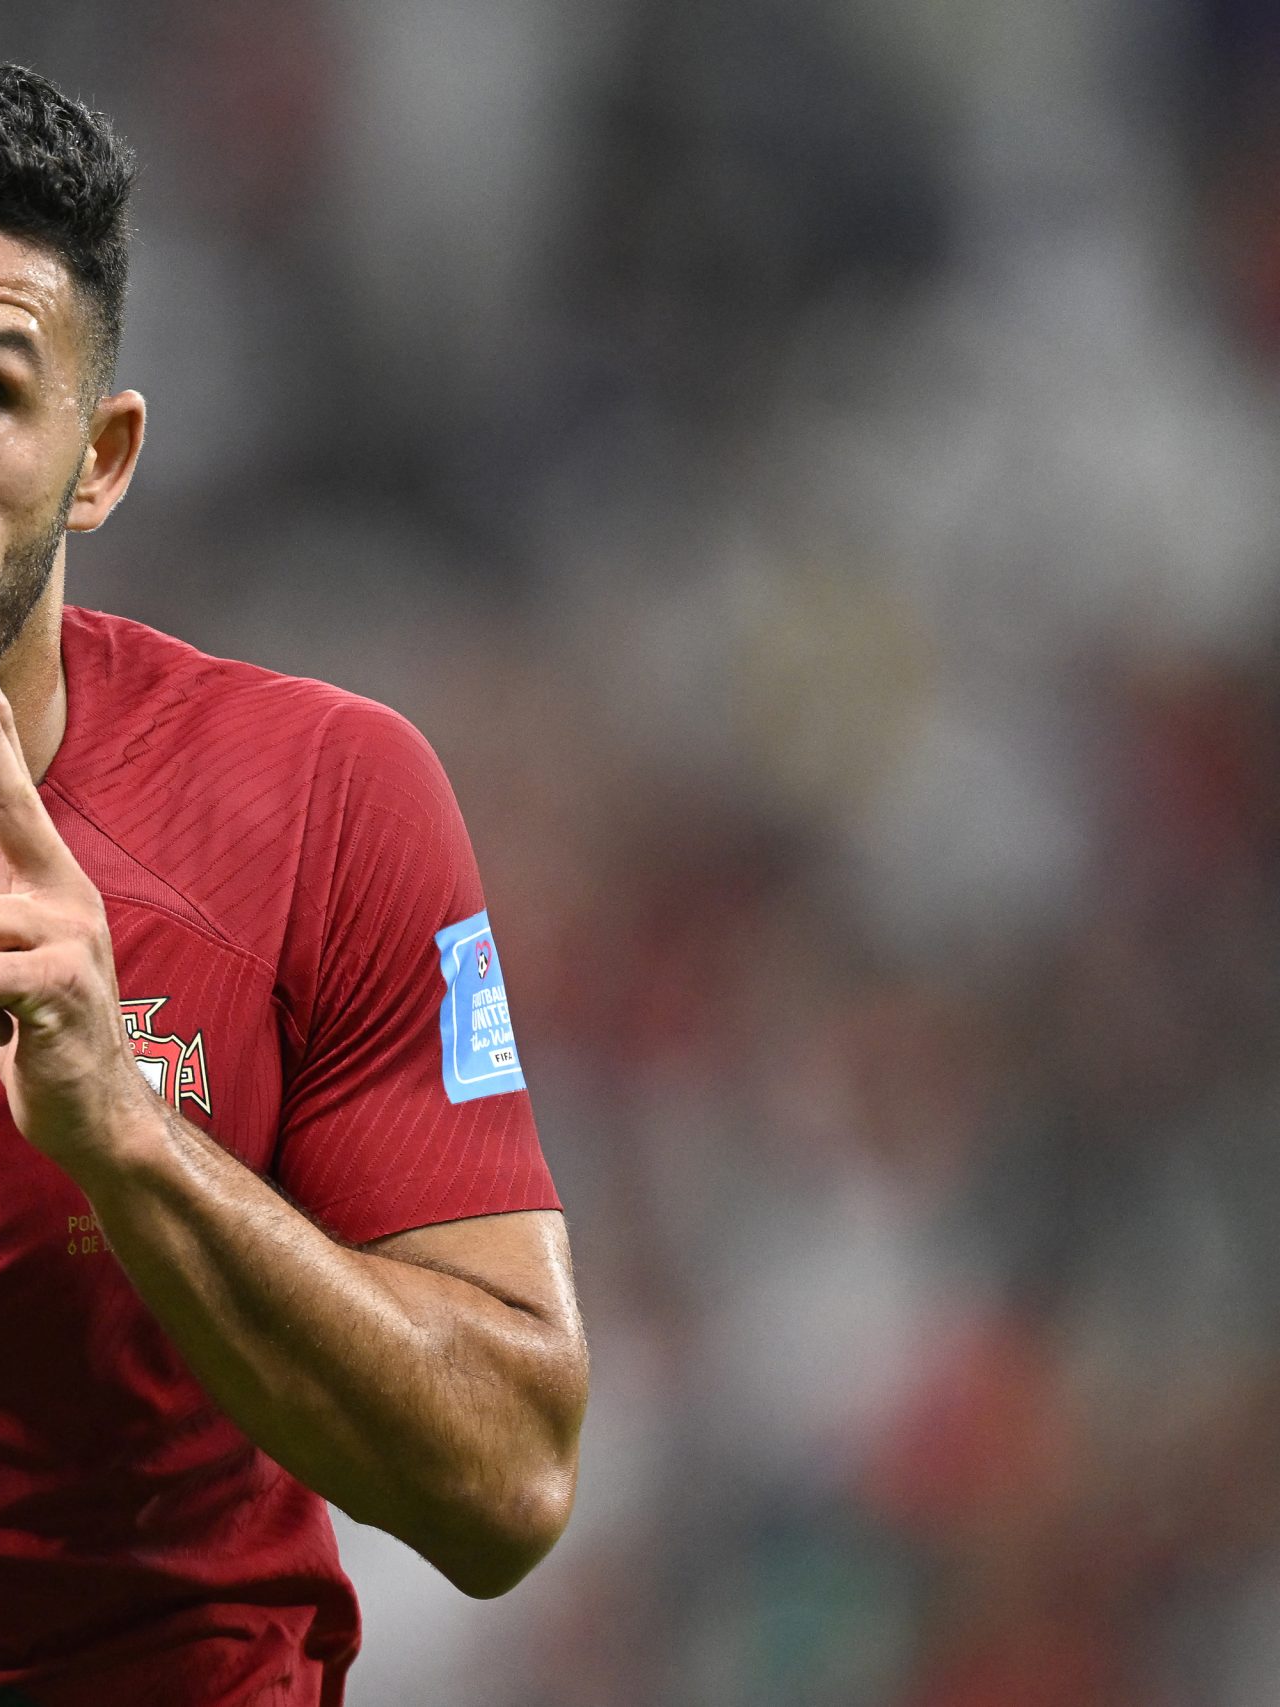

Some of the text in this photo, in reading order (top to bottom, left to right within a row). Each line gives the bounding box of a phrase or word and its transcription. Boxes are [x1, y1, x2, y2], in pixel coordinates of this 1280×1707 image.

[470, 1032, 490, 1052] the
[494, 1051, 513, 1063] FIFA
[67, 1237, 77, 1255] 6
[81, 1235, 98, 1254] DE
